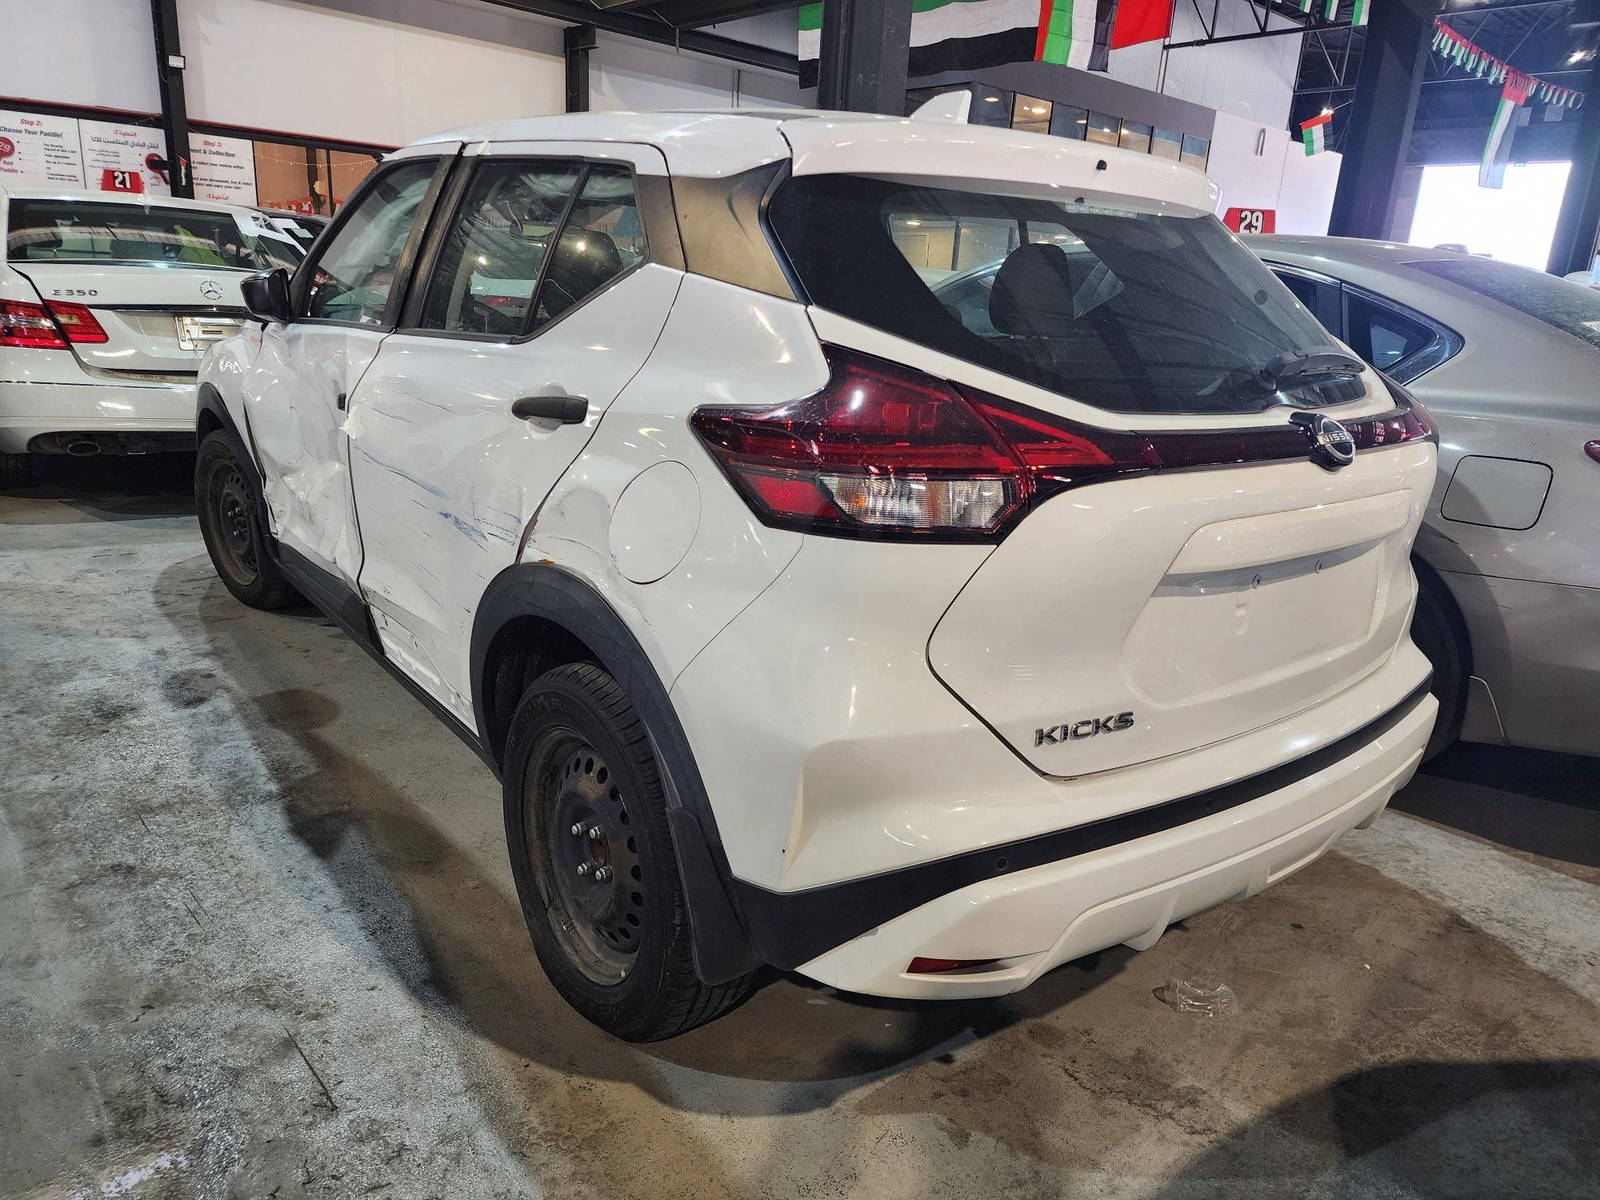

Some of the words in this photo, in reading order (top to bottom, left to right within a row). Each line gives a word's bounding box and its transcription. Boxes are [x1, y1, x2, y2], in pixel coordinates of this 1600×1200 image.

[20, 118, 35, 126] Step
[203, 140, 216, 148] Step
[208, 149, 236, 158] Collection
[113, 171, 131, 189] 21
[1239, 210, 1264, 234] 29
[52, 289, 62, 297] E
[64, 289, 99, 297] 350
[1034, 711, 1135, 748] KICKS
